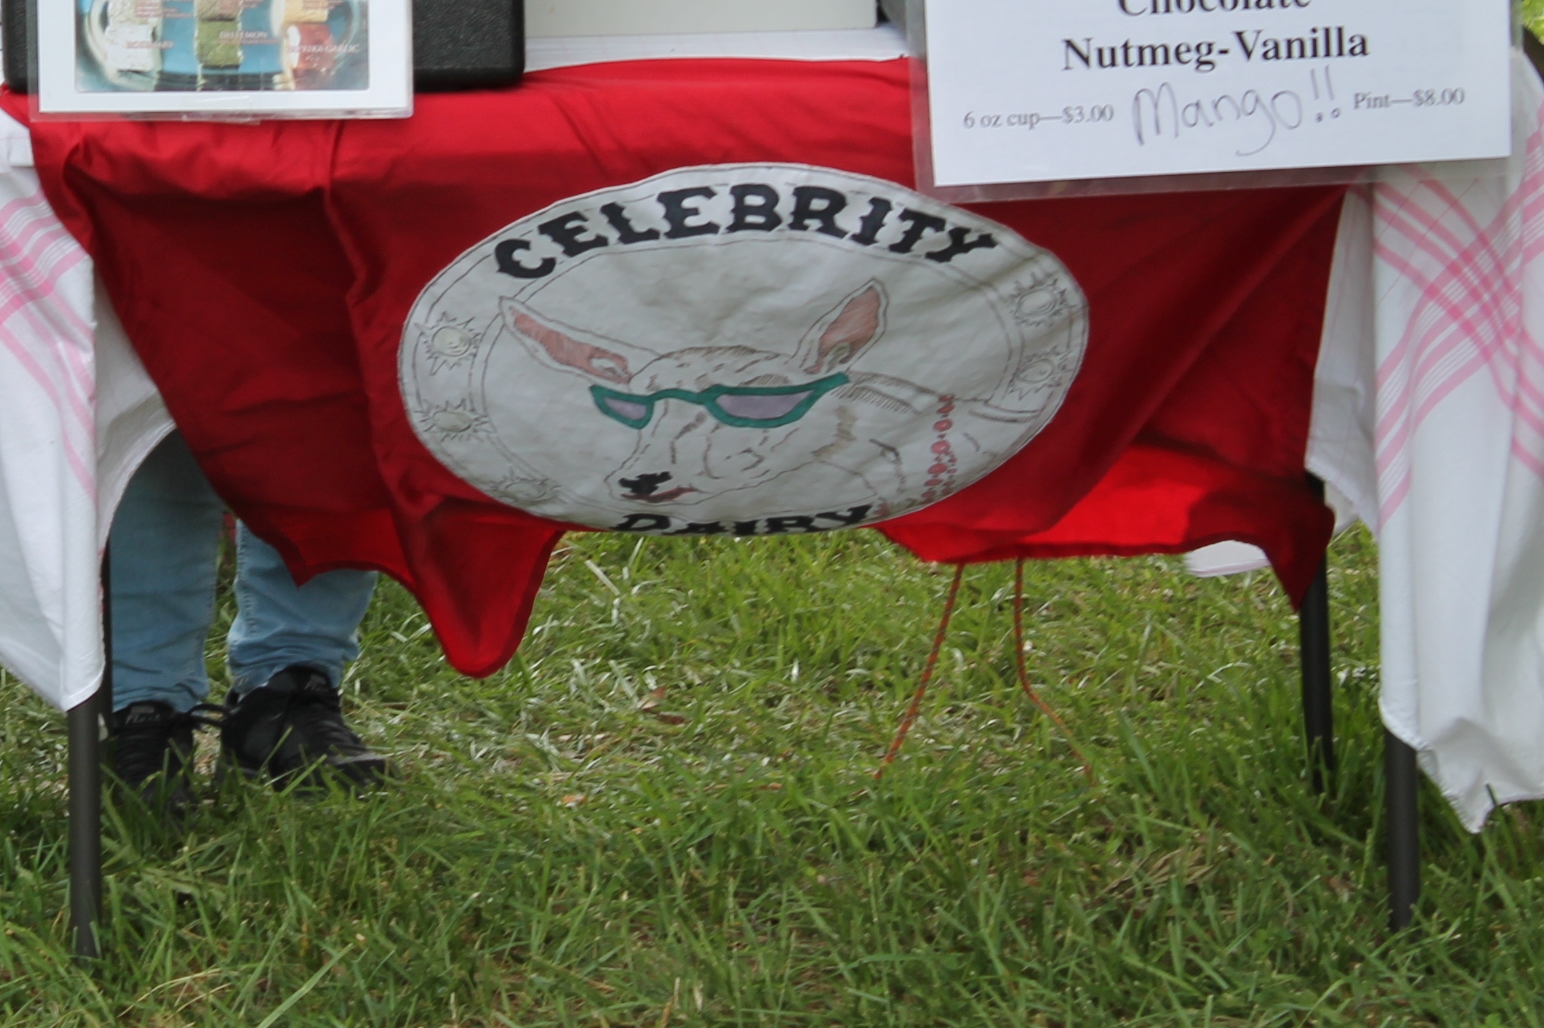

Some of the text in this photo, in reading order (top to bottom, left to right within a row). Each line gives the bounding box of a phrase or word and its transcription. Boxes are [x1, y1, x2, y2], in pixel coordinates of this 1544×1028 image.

[1061, 26, 1370, 73] Nutmeg-Vanilla
[963, 110, 976, 129] 6
[980, 113, 1003, 128] oz
[1130, 65, 1341, 158] Mango!!
[495, 183, 998, 279] CELEBRITY
